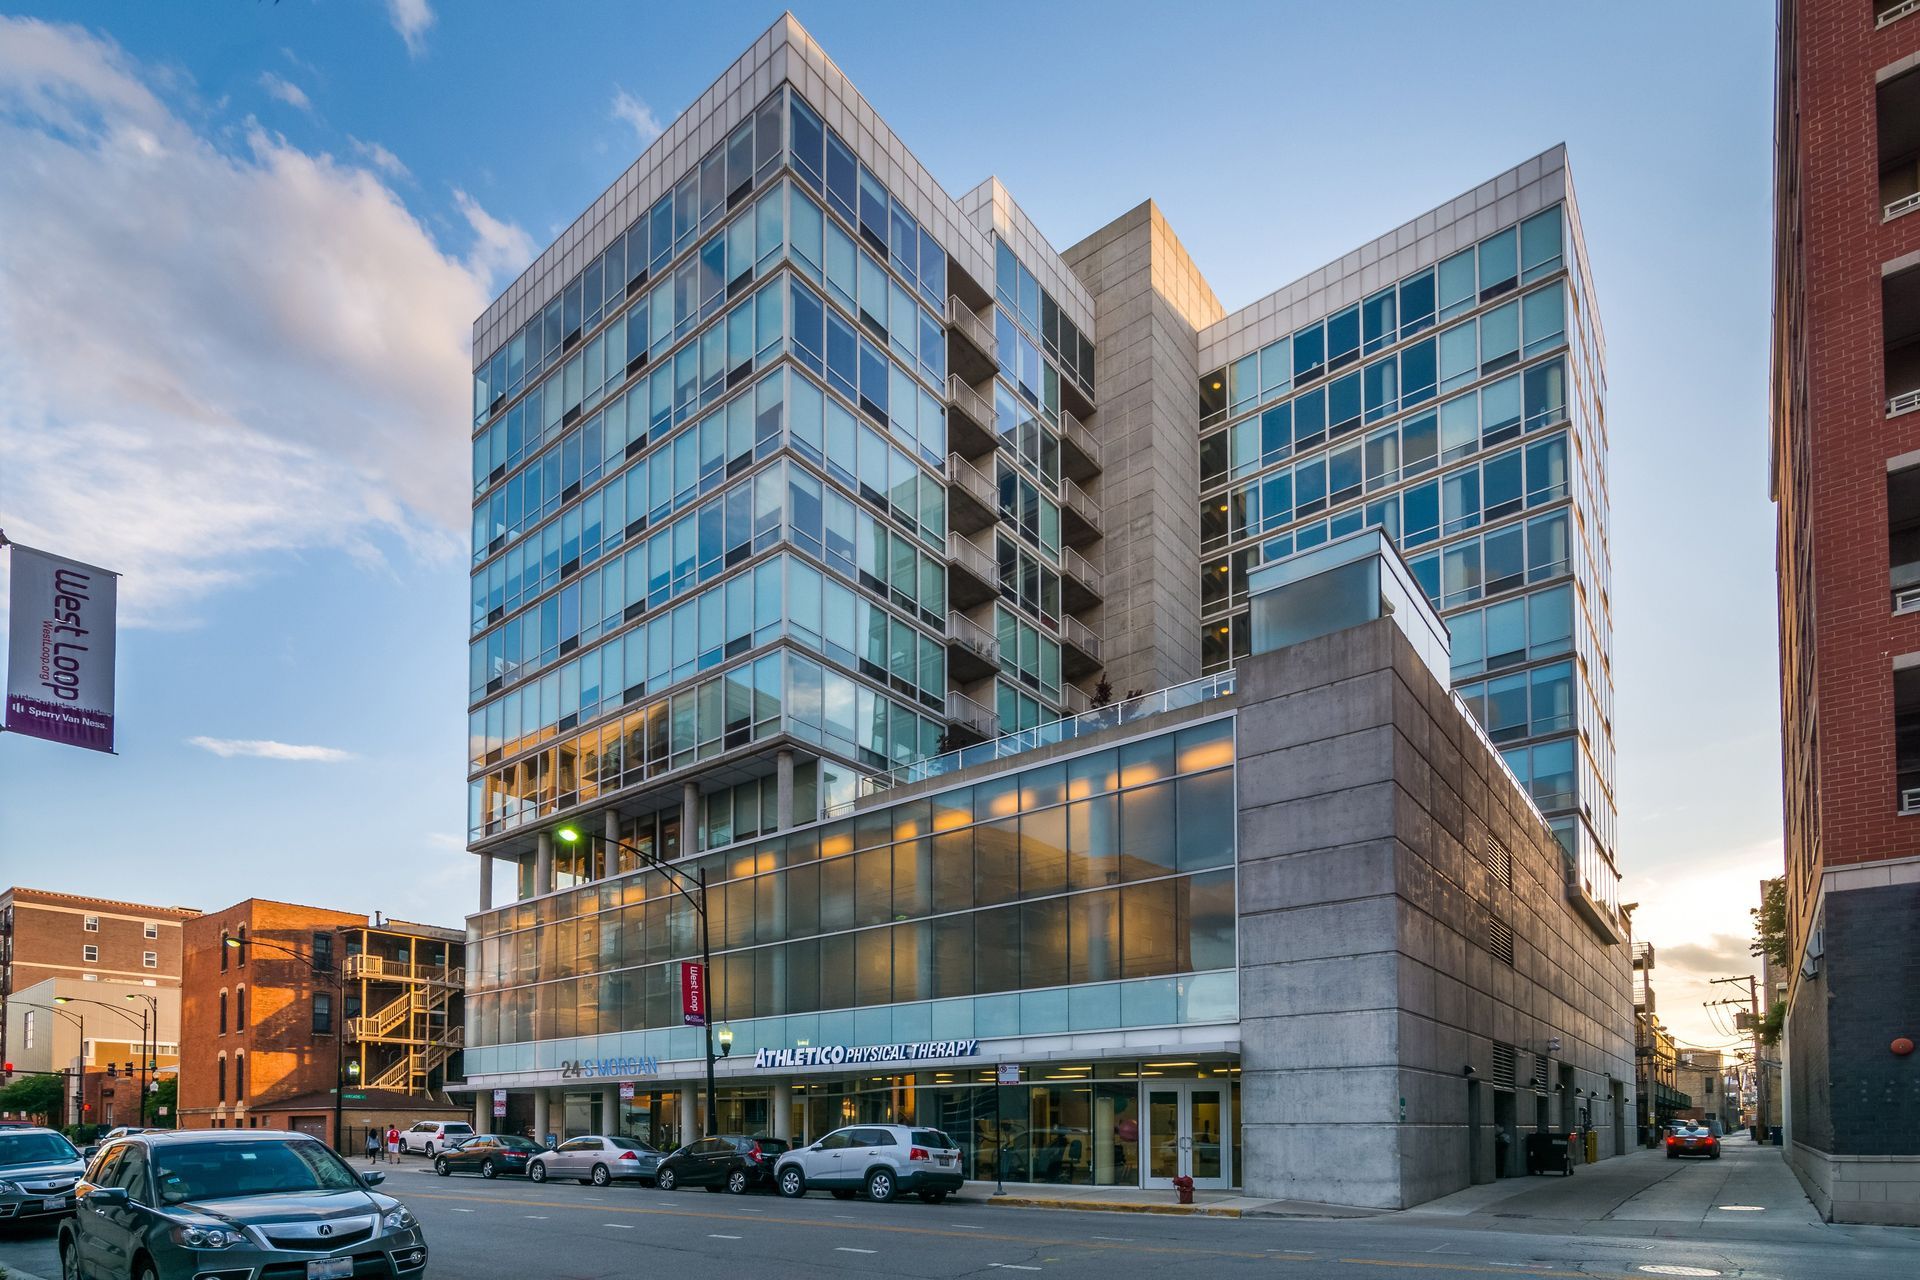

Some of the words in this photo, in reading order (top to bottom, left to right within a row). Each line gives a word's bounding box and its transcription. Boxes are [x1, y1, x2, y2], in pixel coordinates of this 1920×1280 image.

[54, 568, 91, 637] West
[40, 620, 53, 681] WestLoop.org
[42, 642, 89, 701] Loop
[28, 706, 61, 721] Sperry
[62, 713, 80, 725] Van
[690, 966, 699, 990] West
[690, 991, 699, 1011] Loop
[754, 1046, 844, 1067] ATHLETICO
[845, 1044, 907, 1063] PHYSICAL
[911, 1040, 976, 1059] THERAPY
[561, 1060, 581, 1078] 24
[584, 1059, 594, 1077] S
[597, 1056, 658, 1076] MORGAN
